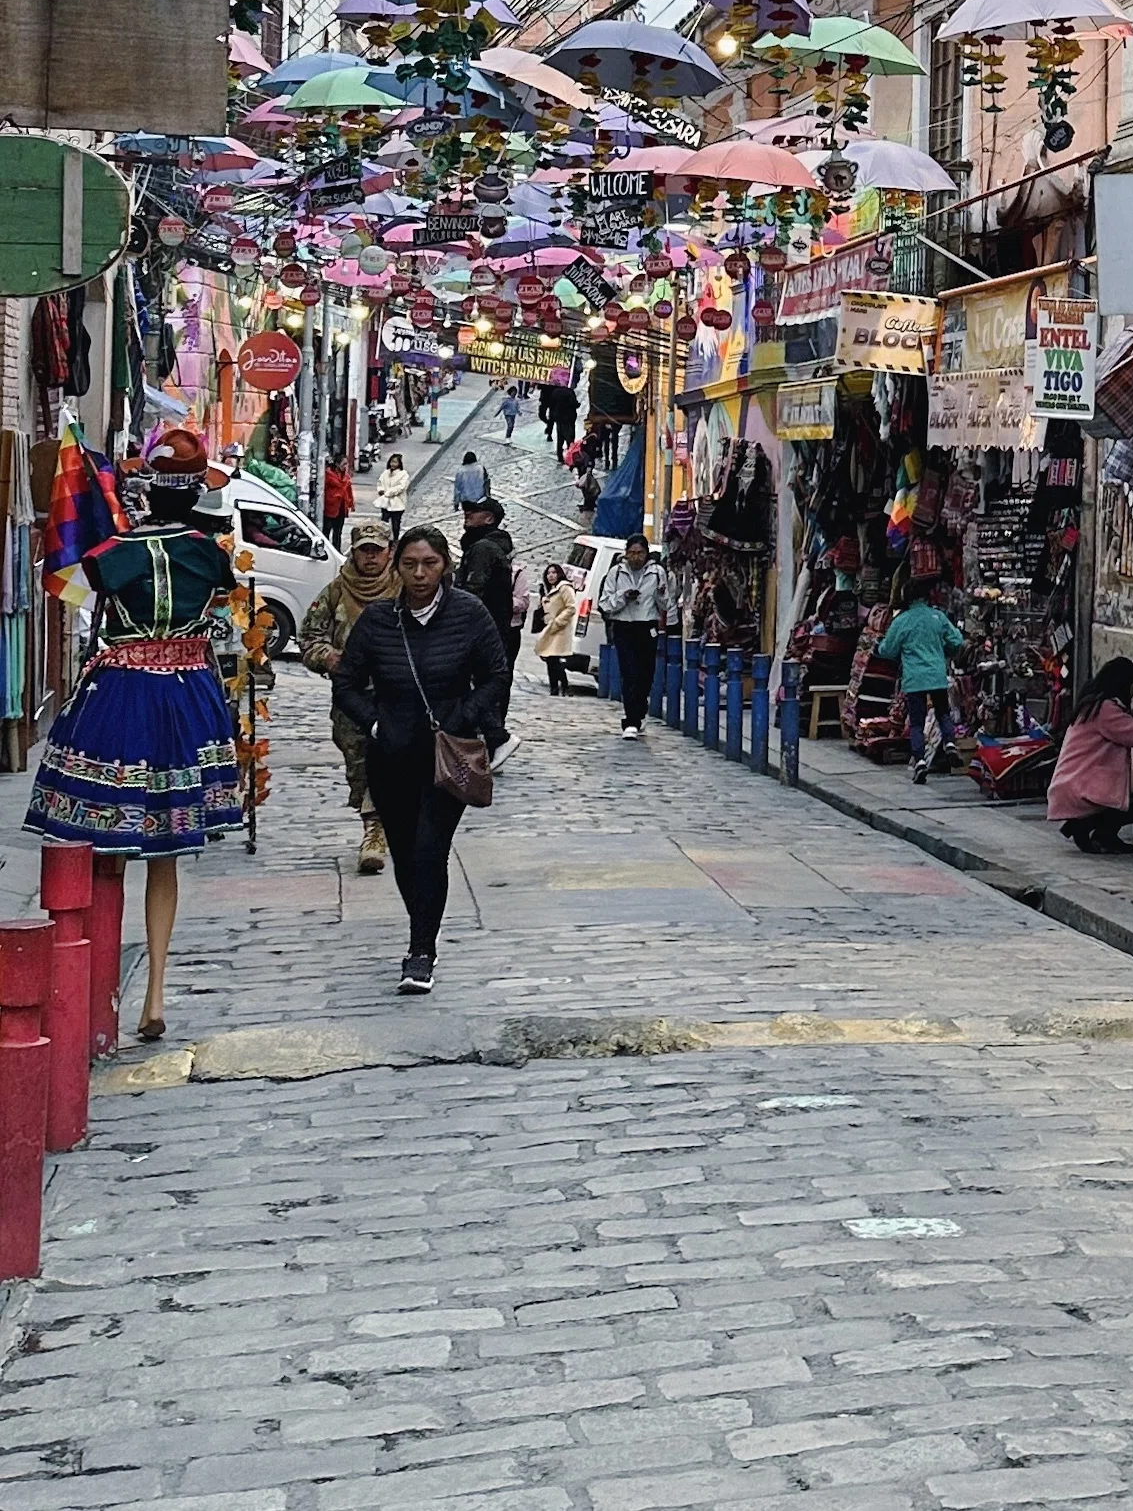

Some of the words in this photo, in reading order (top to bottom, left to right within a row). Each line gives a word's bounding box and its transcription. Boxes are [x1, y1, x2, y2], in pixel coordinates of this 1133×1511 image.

[414, 121, 445, 133] CANDY
[591, 172, 649, 197] WELCOME
[1039, 327, 1091, 350] ENTEL
[458, 341, 503, 359] MERCAO
[518, 348, 535, 364] LAS
[537, 350, 571, 369] BRUJAS
[1044, 349, 1084, 371] VIVA
[470, 357, 507, 374] WITCH
[509, 361, 553, 381] MARKET
[1043, 370, 1083, 392] TIGO
